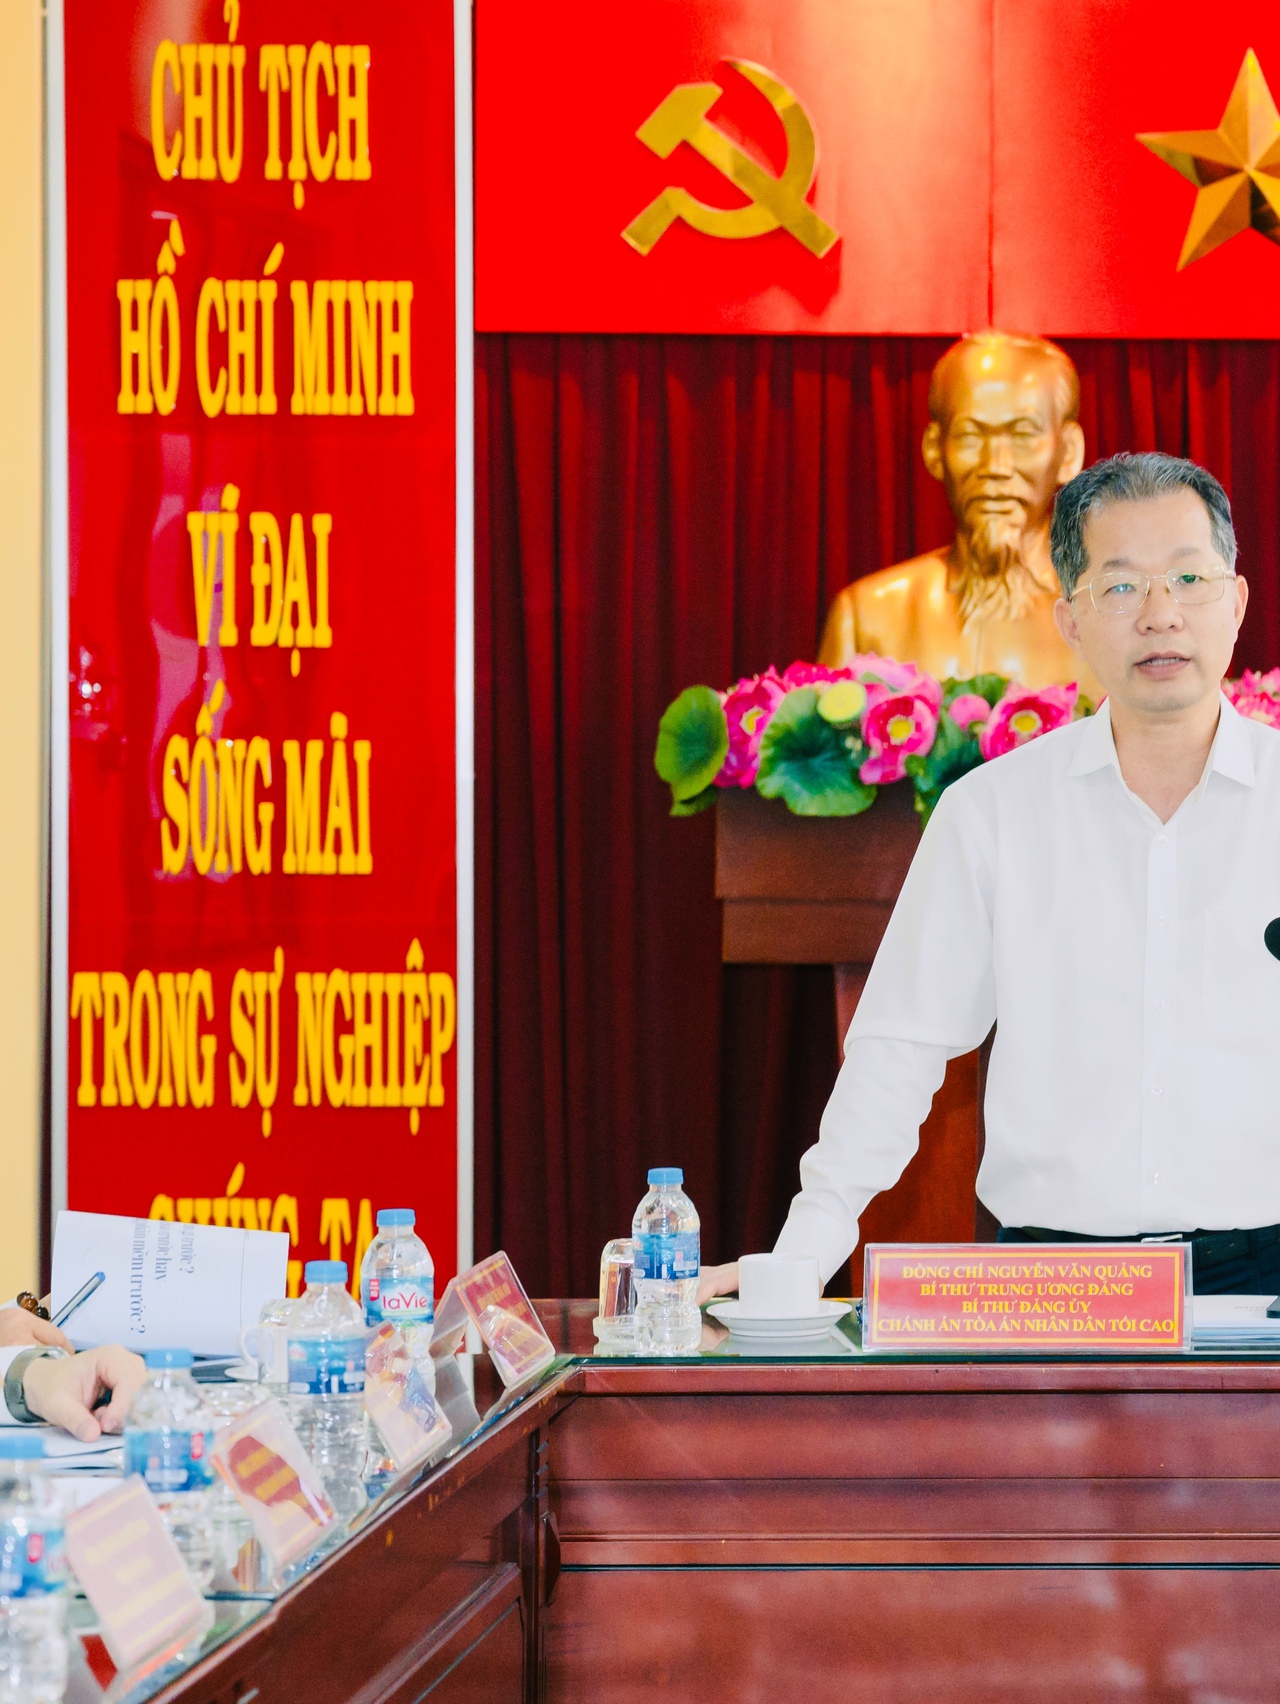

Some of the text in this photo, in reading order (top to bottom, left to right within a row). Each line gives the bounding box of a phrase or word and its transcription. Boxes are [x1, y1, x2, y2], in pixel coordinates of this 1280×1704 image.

[151, 0, 371, 208] CHỦ TỊCH
[117, 219, 414, 417] HỒ CHÍ MINH
[250, 513, 331, 675] ĐẠI
[162, 680, 273, 874] SỐNG
[72, 939, 454, 1136] TRONG SỰ NGHIỆP
[878, 1316, 1175, 1332] CHÁNH ÁN TÒA ÁN NHÂN DÂN TỐI CAO
[903, 1264, 949, 1278] ĐỒNG
[954, 1263, 984, 1278] CHÍ
[988, 1262, 1054, 1278] NGUYỄN
[1058, 1263, 1091, 1278] VĂN
[921, 1280, 1133, 1295] BÍ THƯ TRUNG ƯƠNG ĐẢNG
[962, 1298, 1091, 1313] BÍ THƯ ĐẢNG ỦY
